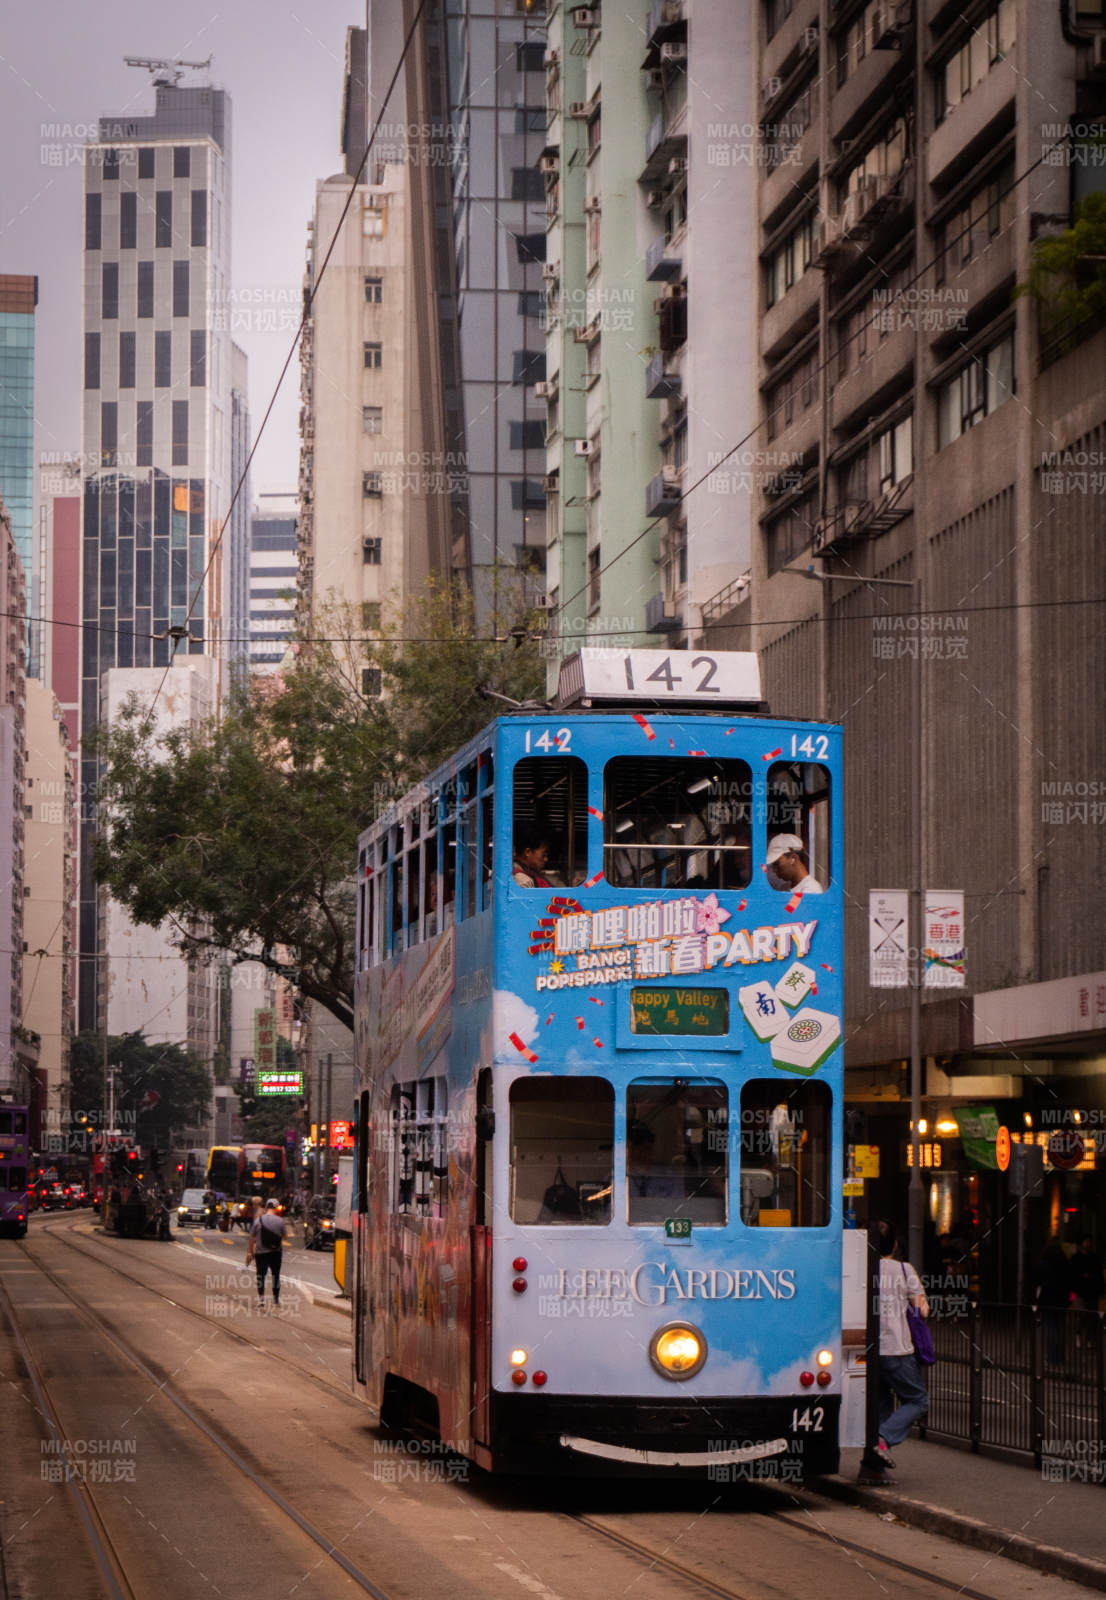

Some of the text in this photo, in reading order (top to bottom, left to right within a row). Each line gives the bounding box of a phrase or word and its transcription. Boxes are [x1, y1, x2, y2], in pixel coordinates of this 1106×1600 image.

[624, 655, 720, 693] 142
[525, 727, 572, 753] 142
[791, 734, 830, 759] 142
[928, 923, 962, 939] 香港
[577, 950, 631, 970] BANG!
[675, 990, 718, 1008] Valley
[755, 992, 777, 1018] 南
[558, 1262, 796, 1306] LEE GARDENS
[792, 1406, 825, 1432] 142
